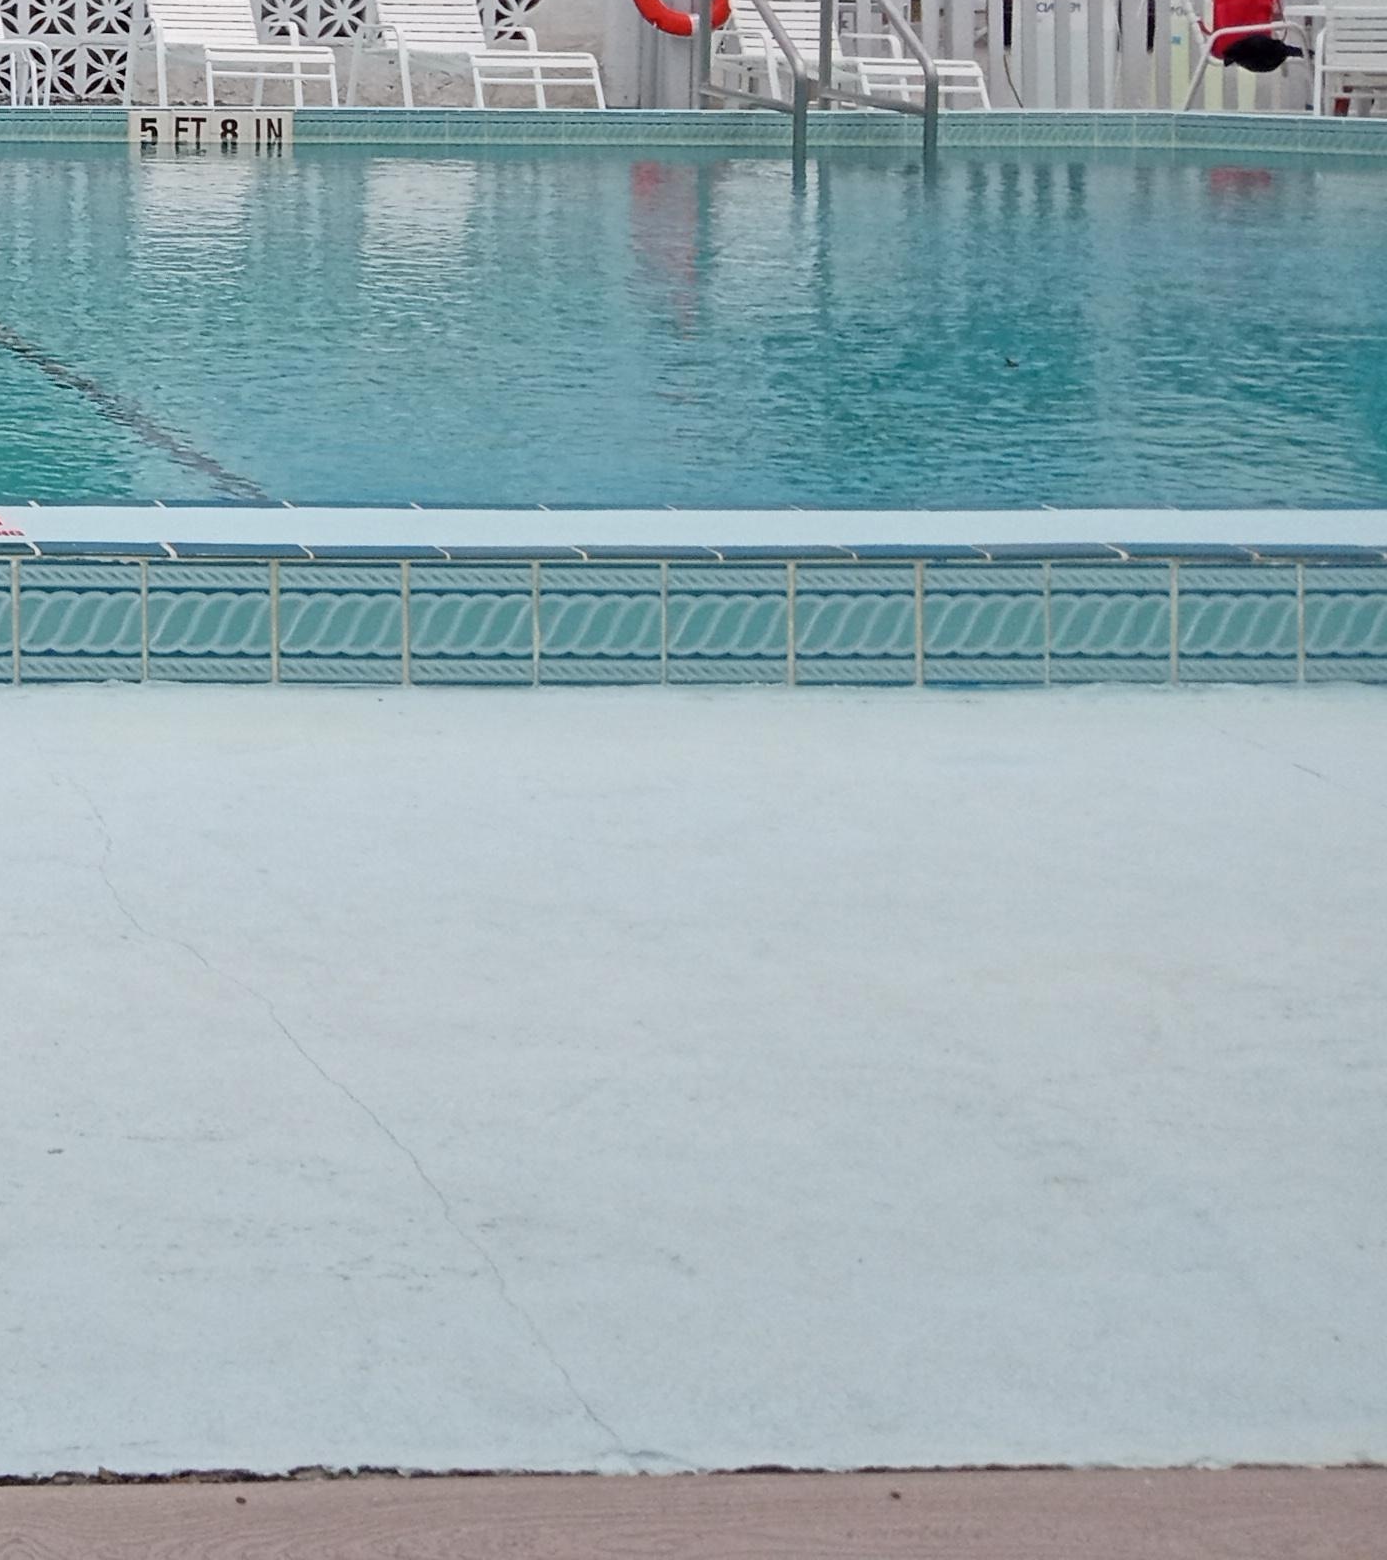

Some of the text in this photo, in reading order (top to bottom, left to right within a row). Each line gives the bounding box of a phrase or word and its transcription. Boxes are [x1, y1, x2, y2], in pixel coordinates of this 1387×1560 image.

[140, 117, 282, 143] 5 FT 8 IN
